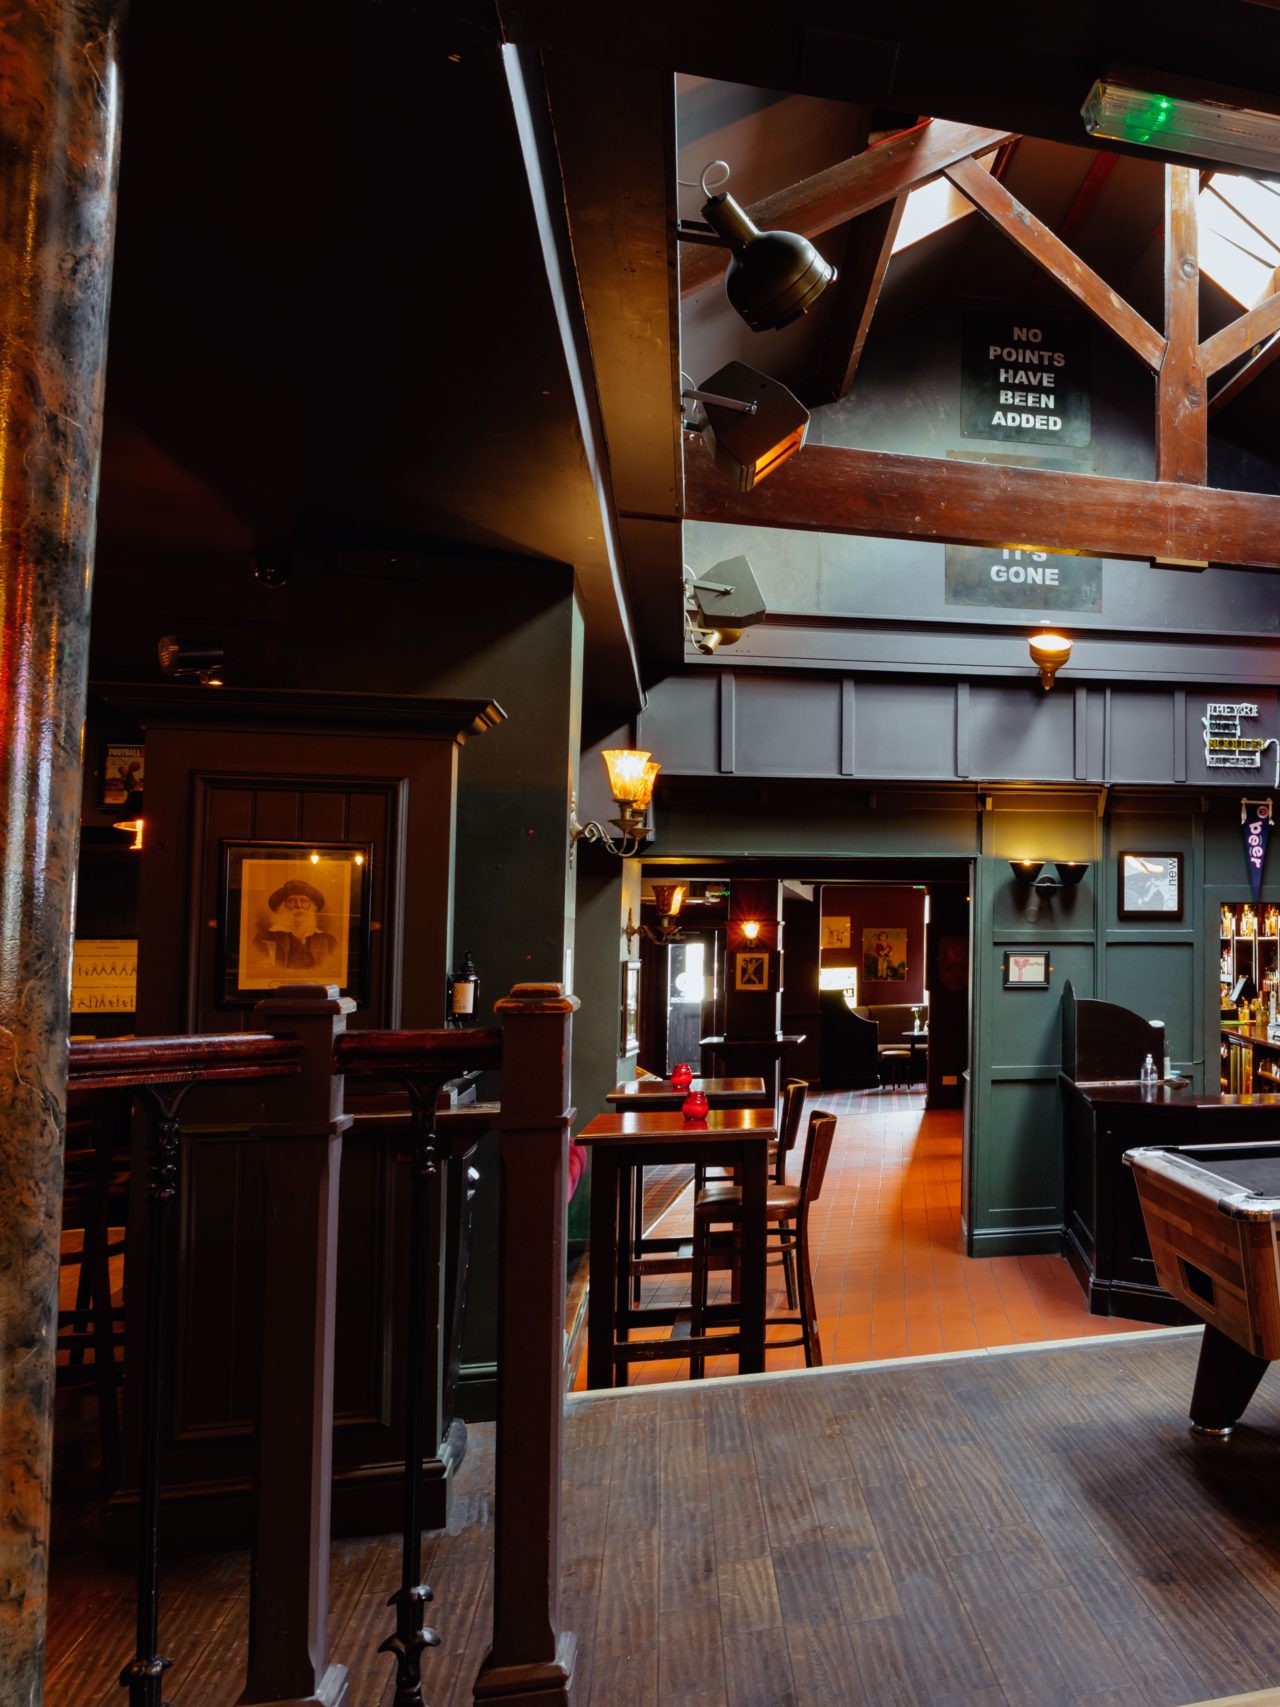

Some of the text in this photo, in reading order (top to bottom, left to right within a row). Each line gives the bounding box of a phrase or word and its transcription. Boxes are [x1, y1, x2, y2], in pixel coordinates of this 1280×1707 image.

[1013, 326, 1043, 343] NO
[989, 346, 1066, 367] POINTS
[999, 368, 1055, 388] HAVE
[999, 389, 1055, 409] BEEN
[991, 411, 1062, 431] ADDED
[1002, 549, 1047, 562] ITS
[990, 565, 1060, 586] GONE
[108, 748, 141, 756] FOOTBALL
[1248, 820, 1264, 868] beer
